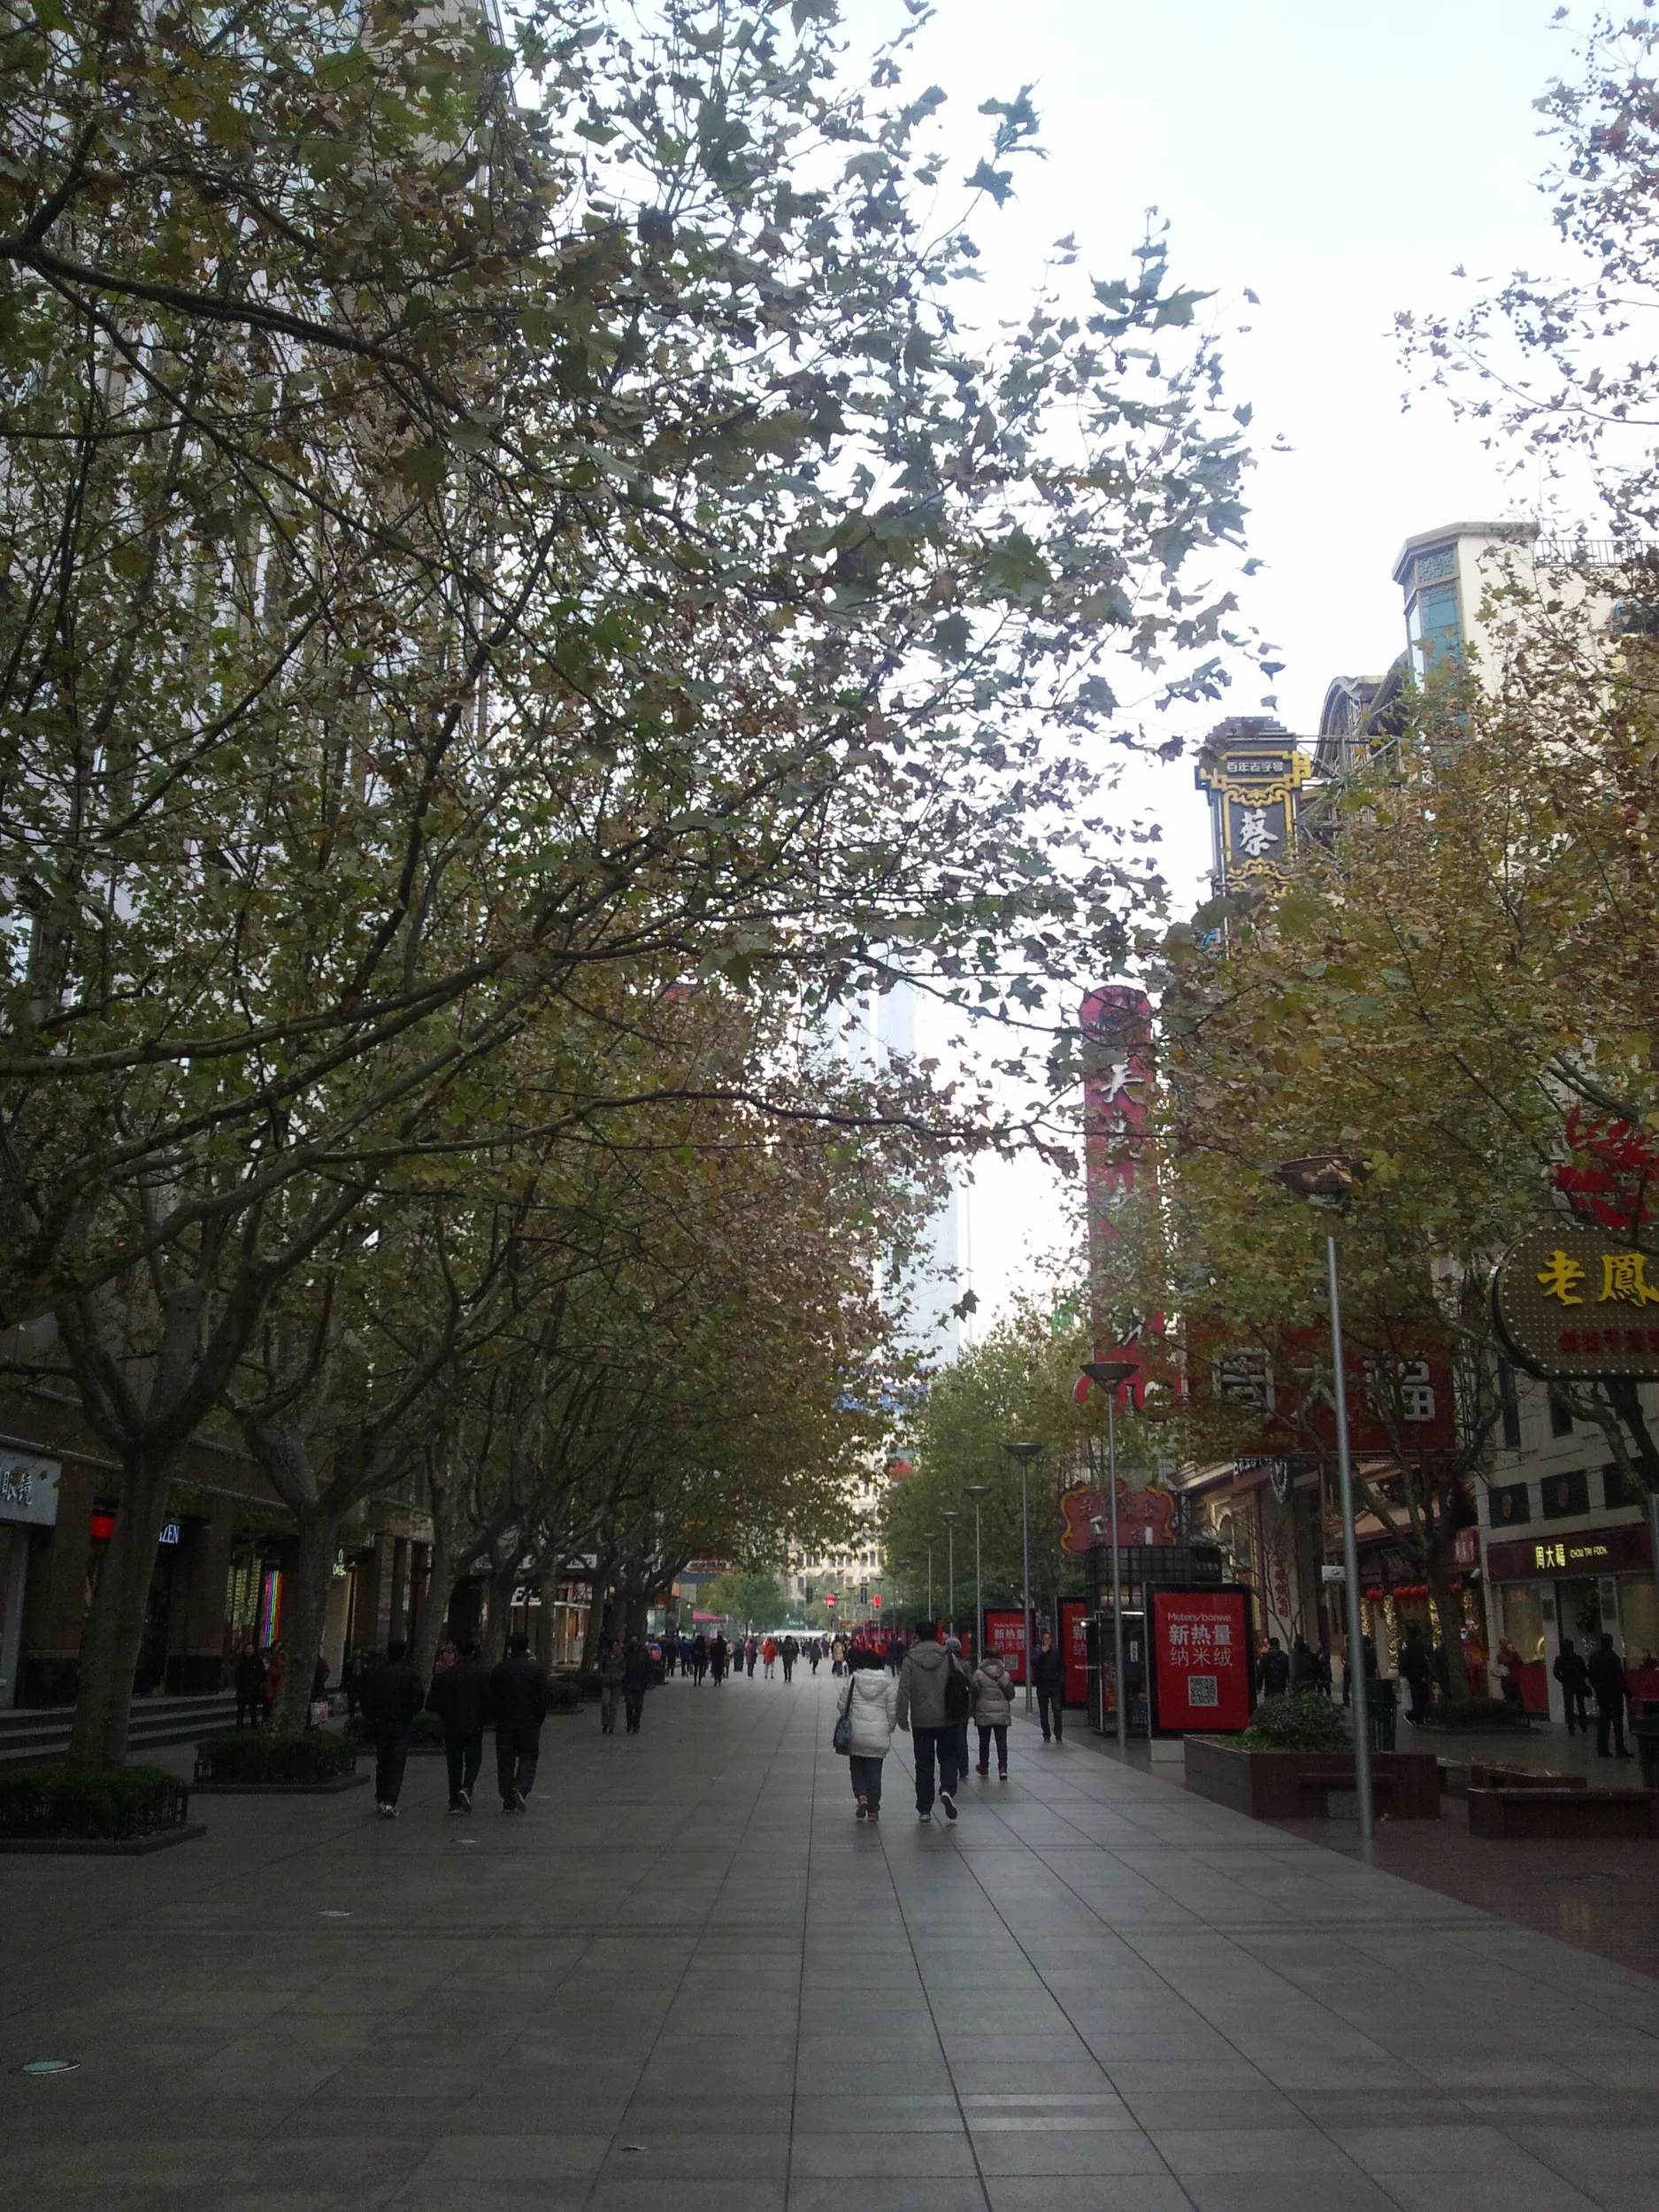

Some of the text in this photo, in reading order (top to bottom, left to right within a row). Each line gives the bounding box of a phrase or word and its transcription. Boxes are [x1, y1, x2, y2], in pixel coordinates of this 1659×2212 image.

[1226, 761, 1284, 773] 百年老字号
[1239, 808, 1279, 856] 蔡
[1535, 1543, 1565, 1570] 周大福
[1167, 1612, 1232, 1622] Meters/bonwe
[1168, 1624, 1233, 1646] 新热量
[1170, 1647, 1233, 1667] 纳米绒
